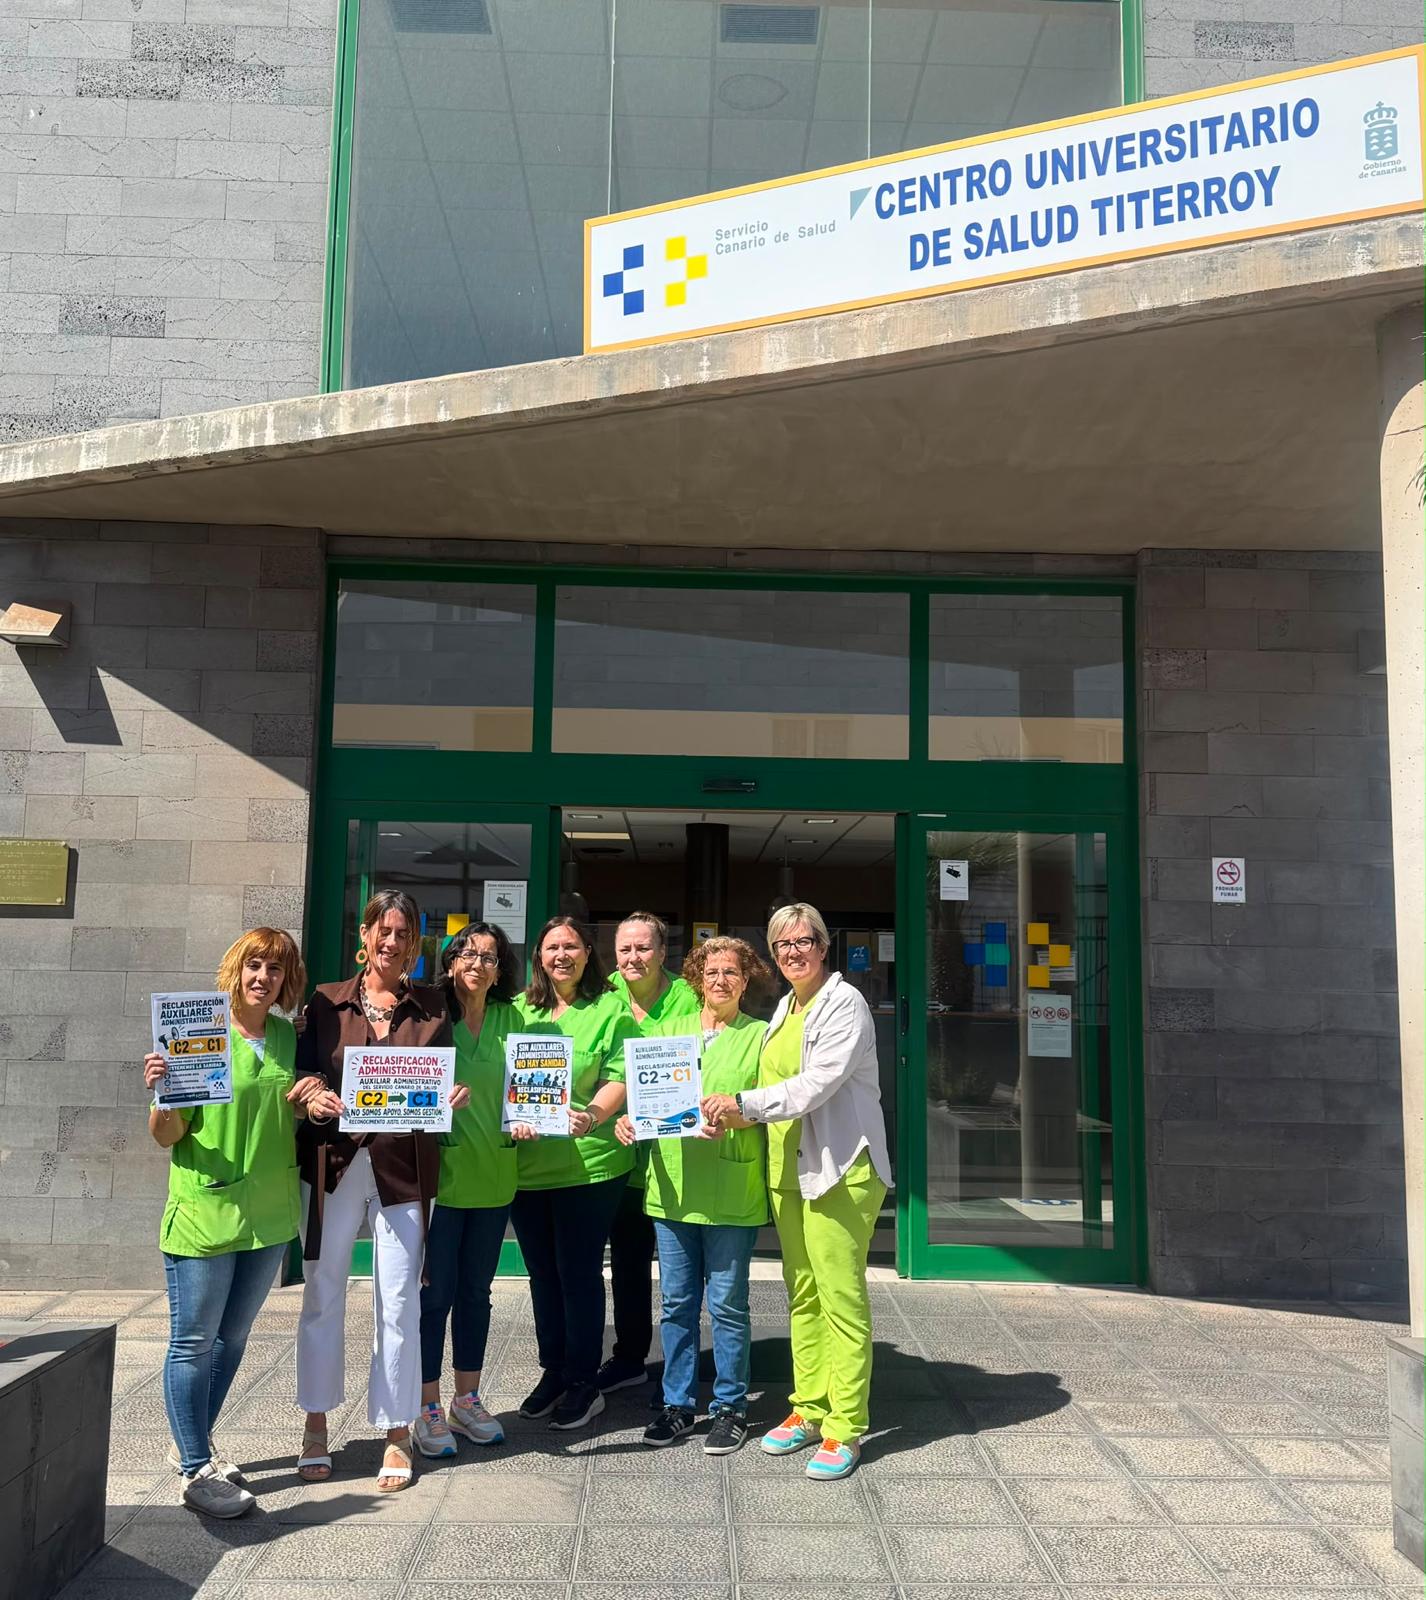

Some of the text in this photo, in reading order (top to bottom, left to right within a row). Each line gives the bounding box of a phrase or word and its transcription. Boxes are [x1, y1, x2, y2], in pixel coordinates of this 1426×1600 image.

[875, 97, 1320, 220] CENTRO UNIVERSITARIO
[1363, 159, 1402, 171] Gobierno
[1358, 165, 1407, 179] de Canarias
[909, 165, 1281, 272] DE SALUD TITERROY
[715, 220, 769, 241] Servicio
[715, 219, 836, 255] Canario de Salud
[161, 998, 224, 1010] RECLASIFICACIÓN
[160, 1007, 213, 1019] AUXILIARES
[161, 1017, 213, 1026] ADMINISTRATIVOS
[213, 1013, 225, 1027] YA
[173, 1038, 221, 1054] C2 C1
[518, 1043, 563, 1052] SIN AUXILIARES
[635, 1045, 662, 1053] AUXILIARES
[518, 1051, 564, 1059] ADMINISTRATIVOS
[635, 1051, 677, 1060] ADMINISTRATIVOS
[516, 1058, 566, 1069] NO HAY SANIDAD
[636, 1061, 690, 1070] RECLASIFICACIÓN
[358, 1066, 443, 1076] ADMINISTRATIVA YA
[638, 1068, 691, 1085] C2 C1
[393, 1078, 442, 1086] ADMINISTRATIVO
[361, 1093, 433, 1106] C2 C1
[516, 1093, 562, 1104] C2 C1 YA
[350, 1108, 361, 1116] NO
[362, 1108, 382, 1116] SOMOS
[403, 1108, 421, 1116] SOMOS
